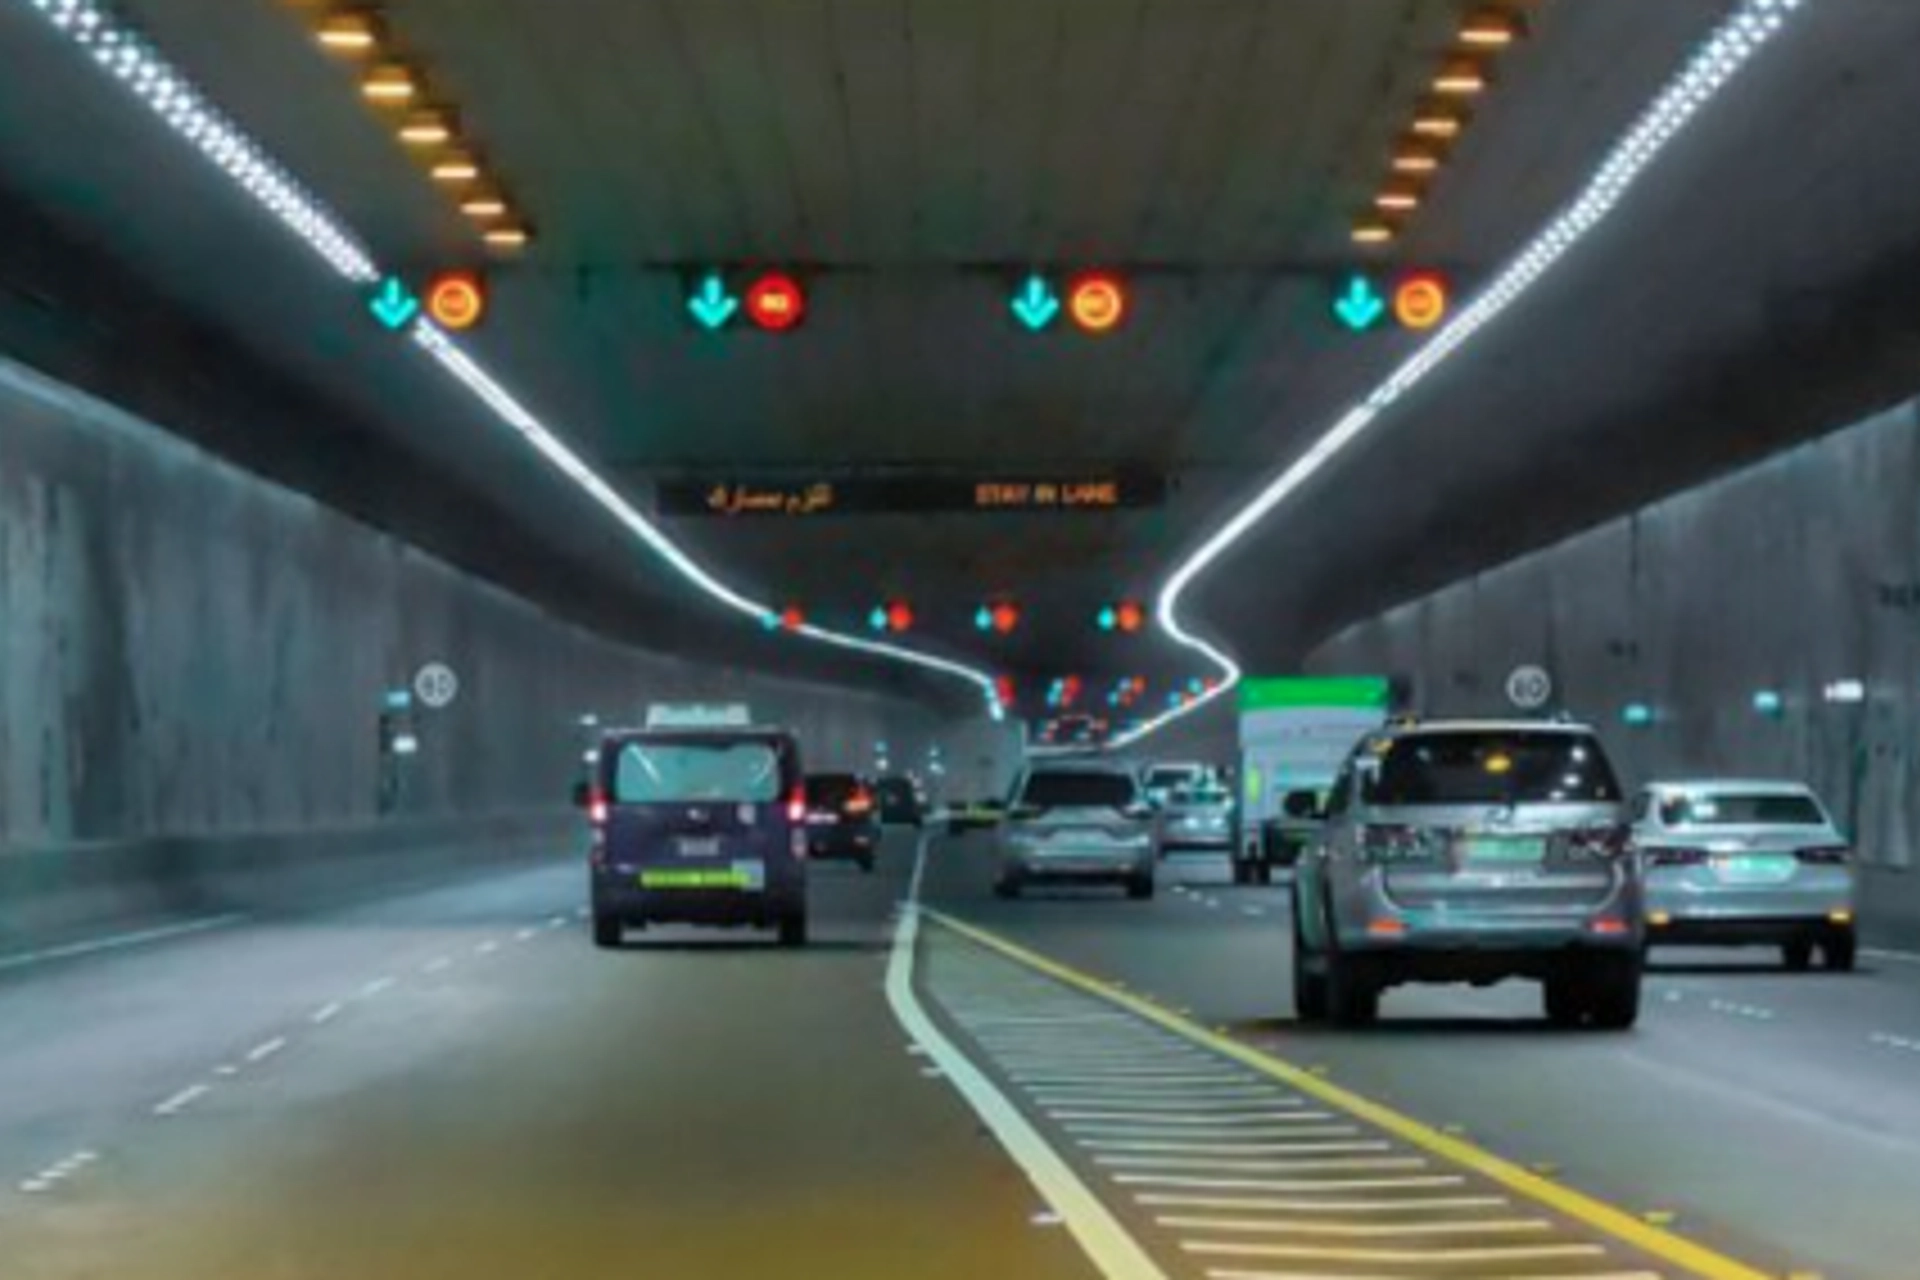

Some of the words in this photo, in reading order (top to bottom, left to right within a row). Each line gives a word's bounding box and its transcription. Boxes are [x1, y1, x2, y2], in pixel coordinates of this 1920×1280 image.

[974, 483, 1031, 505] STAY
[1033, 483, 1058, 505] IN
[1060, 483, 1118, 505] LANE
